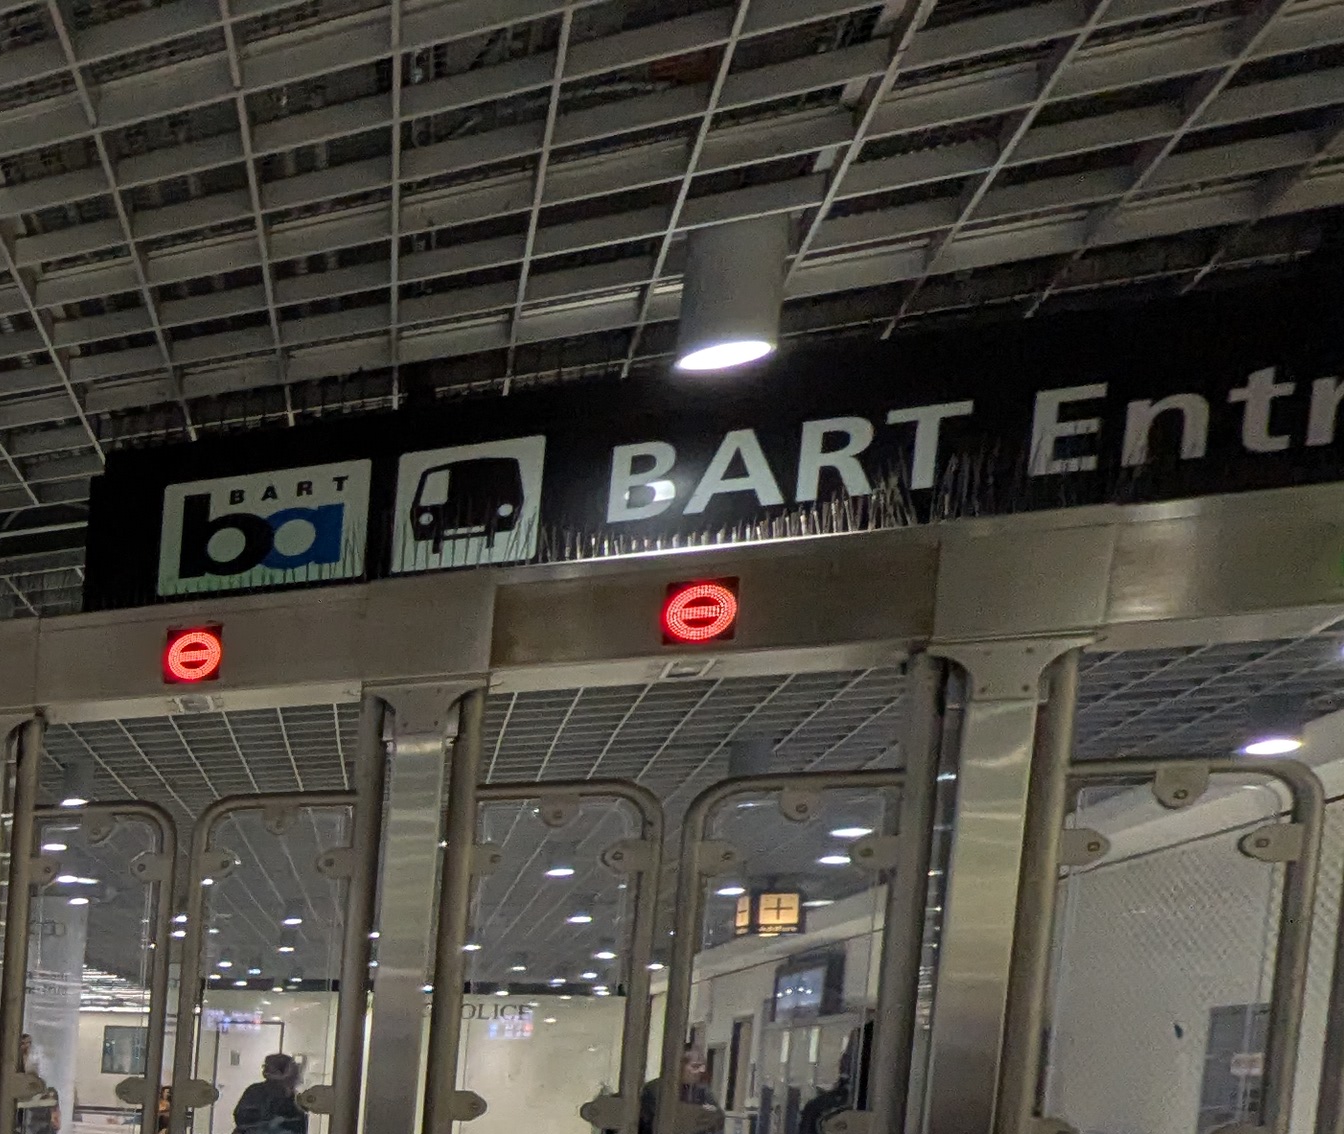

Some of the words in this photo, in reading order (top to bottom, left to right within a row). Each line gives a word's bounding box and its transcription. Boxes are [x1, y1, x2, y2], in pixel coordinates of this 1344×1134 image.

[605, 400, 975, 523] BART
[229, 476, 349, 505] BART
[461, 1003, 534, 1020] OLICE
